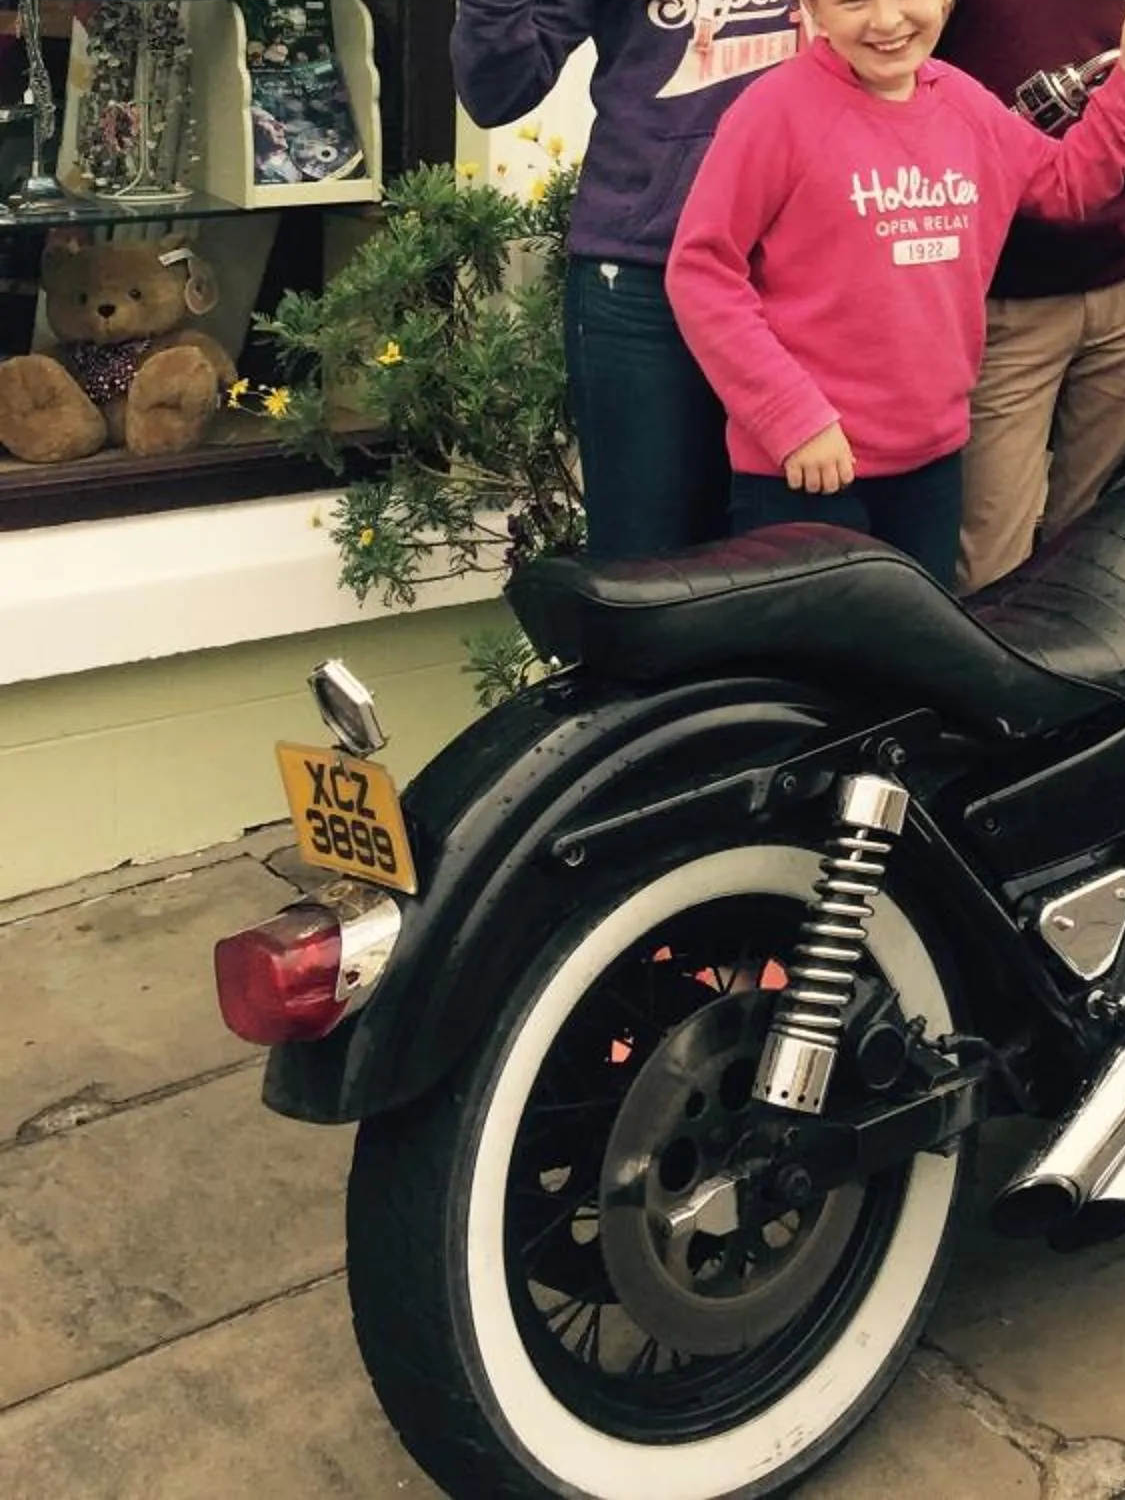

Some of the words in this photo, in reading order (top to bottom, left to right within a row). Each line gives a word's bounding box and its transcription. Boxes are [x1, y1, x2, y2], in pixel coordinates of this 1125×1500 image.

[850, 165, 979, 217] Hollister
[875, 217, 919, 237] OPEN
[922, 214, 970, 232] RELAY
[908, 241, 944, 261] 1922
[303, 760, 377, 821] XCZ
[305, 807, 397, 875] 3899
